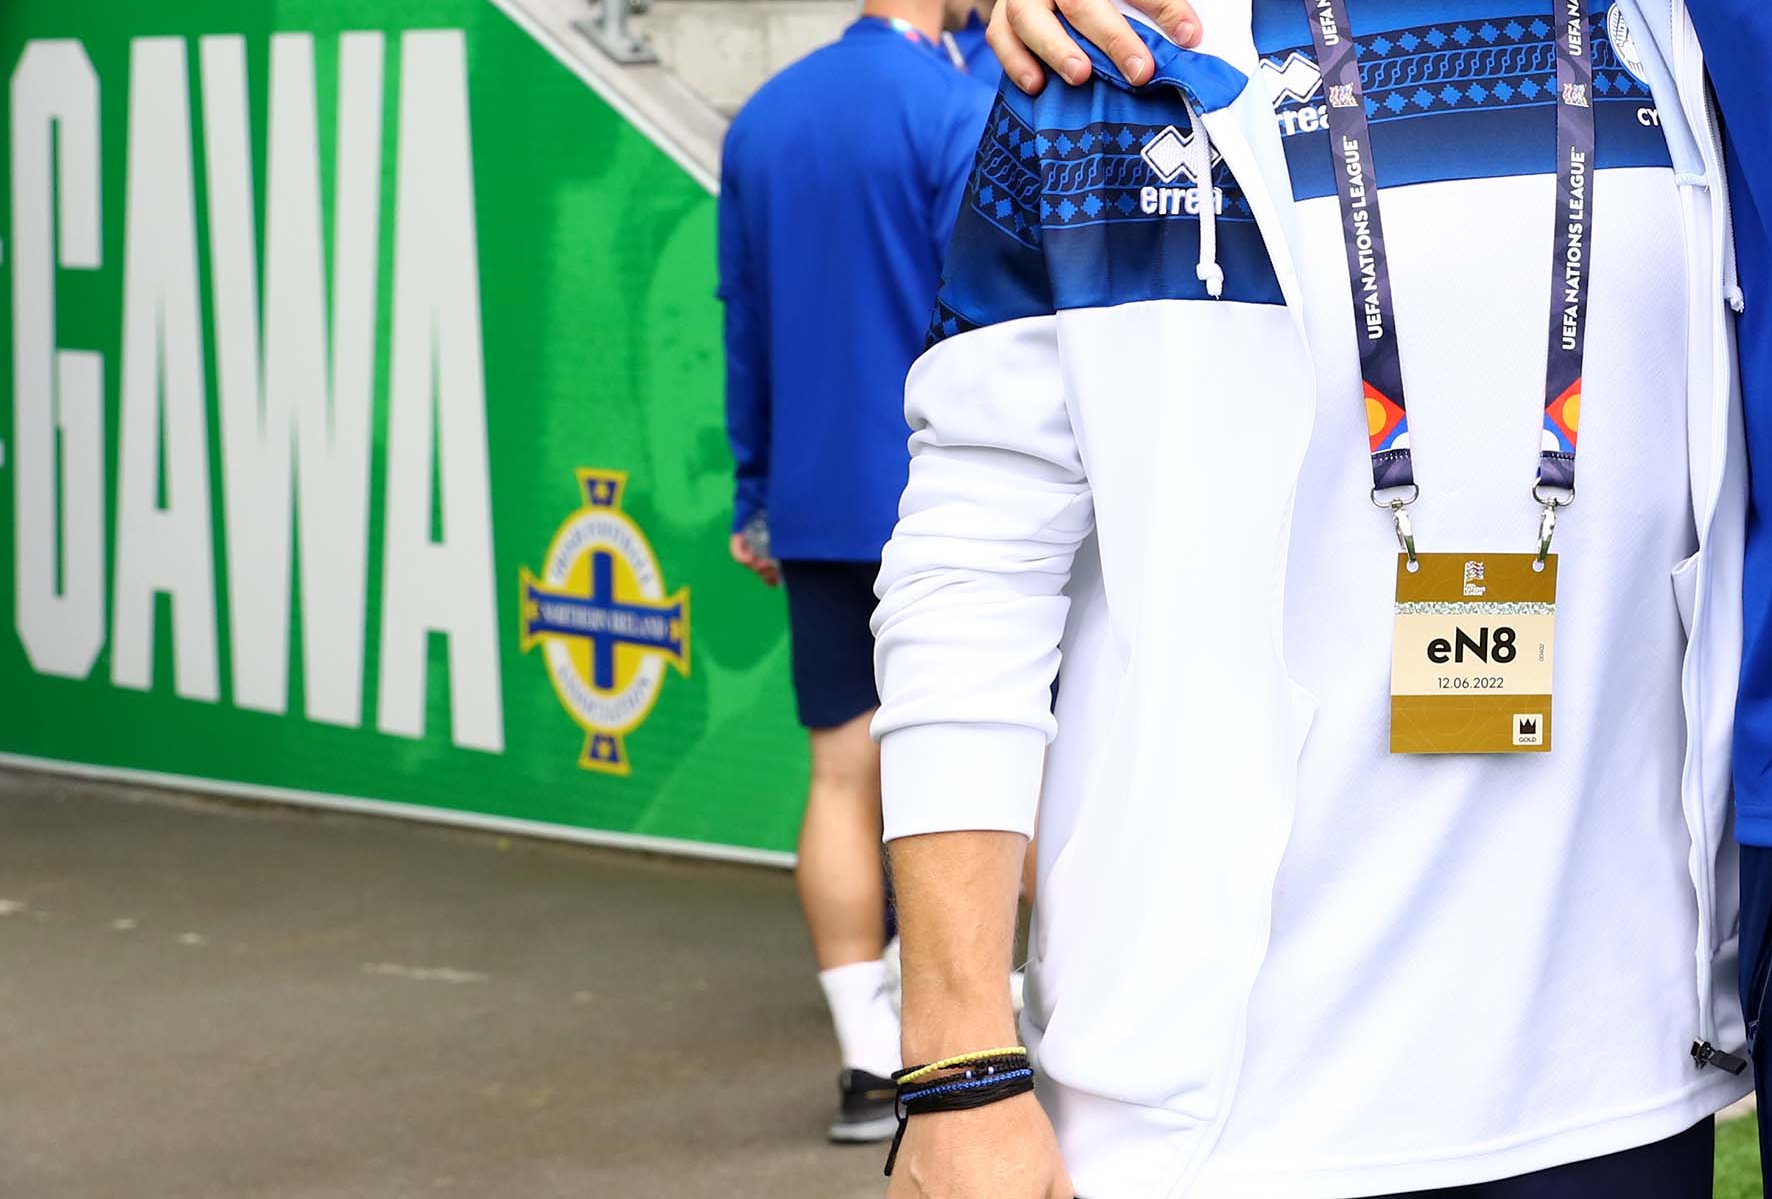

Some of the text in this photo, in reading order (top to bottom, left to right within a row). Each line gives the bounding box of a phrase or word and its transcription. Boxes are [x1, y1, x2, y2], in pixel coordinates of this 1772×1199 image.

[1319, 7, 1340, 46] UEFA
[1568, 18, 1582, 57] UEFA
[1343, 138, 1385, 340] UEFA NATIONS LEAGUE
[1562, 149, 1586, 351] UEFA NATIONS LEAGUE
[0, 27, 506, 755] GAWA
[1427, 626, 1517, 664] eN8
[1438, 677, 1504, 689] 12.06.2022
